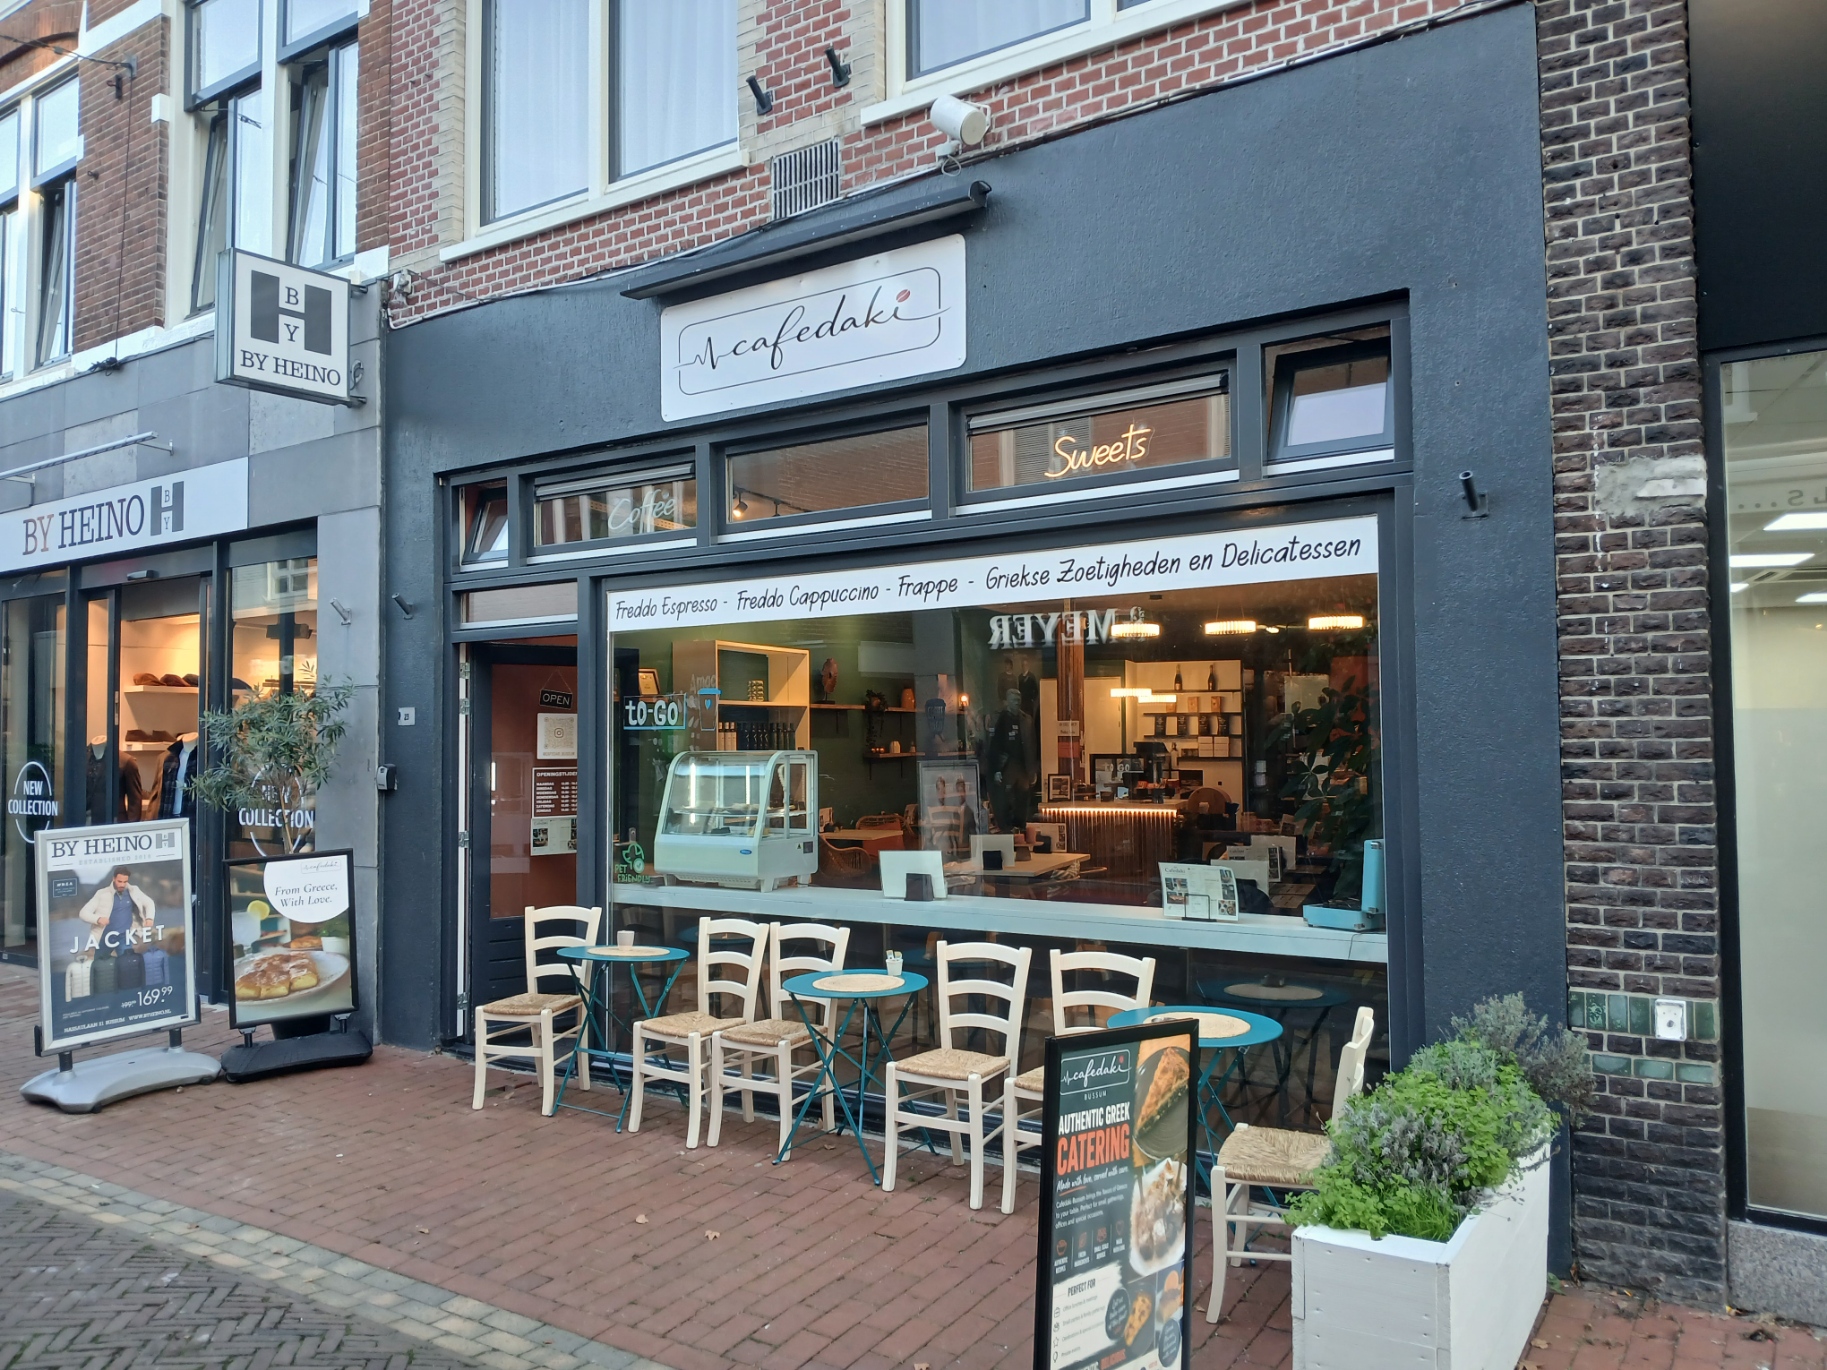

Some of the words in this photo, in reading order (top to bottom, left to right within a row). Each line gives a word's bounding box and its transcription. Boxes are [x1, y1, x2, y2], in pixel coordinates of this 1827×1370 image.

[285, 286, 299, 305] B
[285, 323, 299, 342] Y
[724, 285, 925, 370] cafedaki
[240, 350, 268, 374] BY
[273, 361, 341, 386] HEINO
[1044, 424, 1152, 478] Sweets
[164, 489, 171, 503] B
[608, 489, 676, 534] Coffee
[22, 514, 54, 556] BY
[58, 494, 145, 549] HEINO
[164, 516, 170, 530] Y
[616, 600, 657, 620] Freddo
[662, 596, 718, 621] Espresso
[737, 590, 784, 610] Freddo
[789, 584, 879, 612] Cappuccino
[898, 574, 958, 602] Frappe
[986, 566, 1050, 590] Griekse
[1057, 551, 1180, 587] Zoetigheden
[1189, 553, 1213, 571] en
[1221, 535, 1361, 568] Delicatessen
[542, 693, 570, 706] OPEN
[23, 781, 43, 795] NEW
[8, 799, 58, 816] COLLECTION
[51, 841, 79, 858] BY
[84, 835, 152, 855] HEINO
[275, 886, 300, 896] From
[303, 883, 338, 893] Greece,
[280, 896, 304, 907] With
[308, 896, 333, 905] Love.
[69, 925, 165, 954] JACKET
[1073, 1056, 1127, 1087] cafedaki
[1084, 1090, 1107, 1100] BUSSUM
[1058, 1107, 1104, 1135] AUTHENTIC
[1105, 1102, 1130, 1125] GREEK
[1057, 1123, 1130, 1175] CATERING
[1068, 1282, 1086, 1297] PERFECT
[1087, 1278, 1096, 1290] FOR
